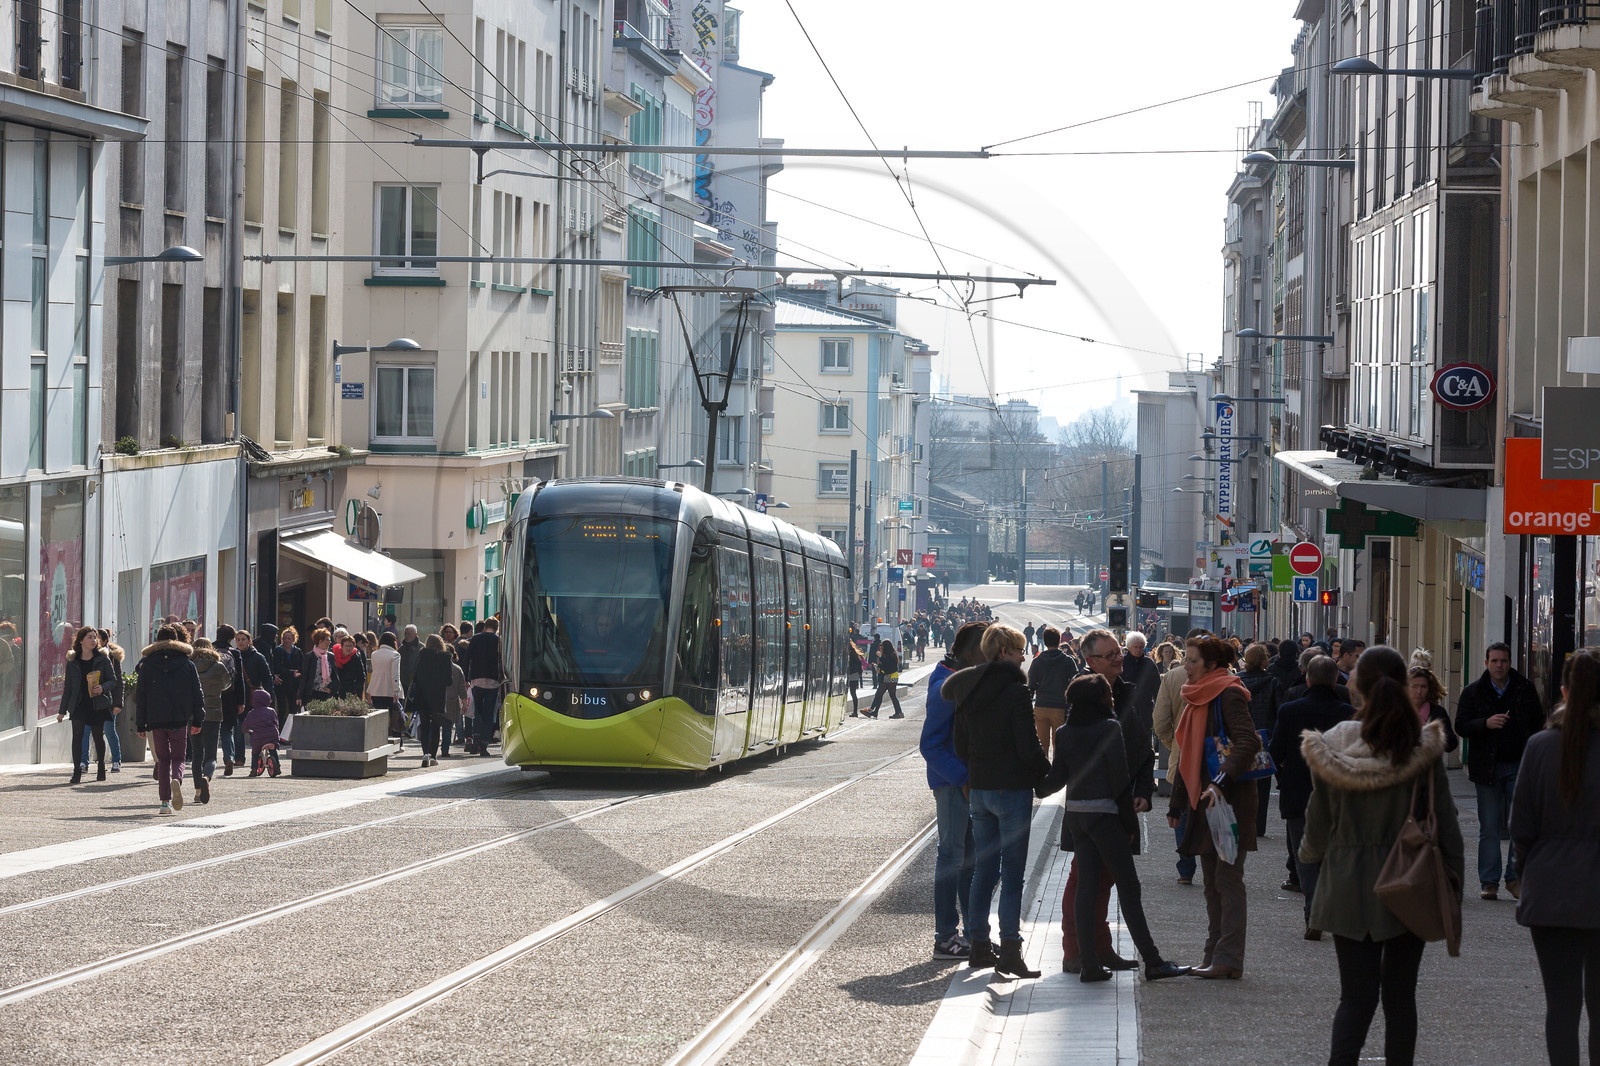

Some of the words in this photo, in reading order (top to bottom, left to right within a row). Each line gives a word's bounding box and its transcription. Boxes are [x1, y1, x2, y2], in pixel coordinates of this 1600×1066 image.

[1443, 375, 1484, 397] C&A
[1509, 511, 1591, 532] orange
[571, 693, 607, 706] bibus
